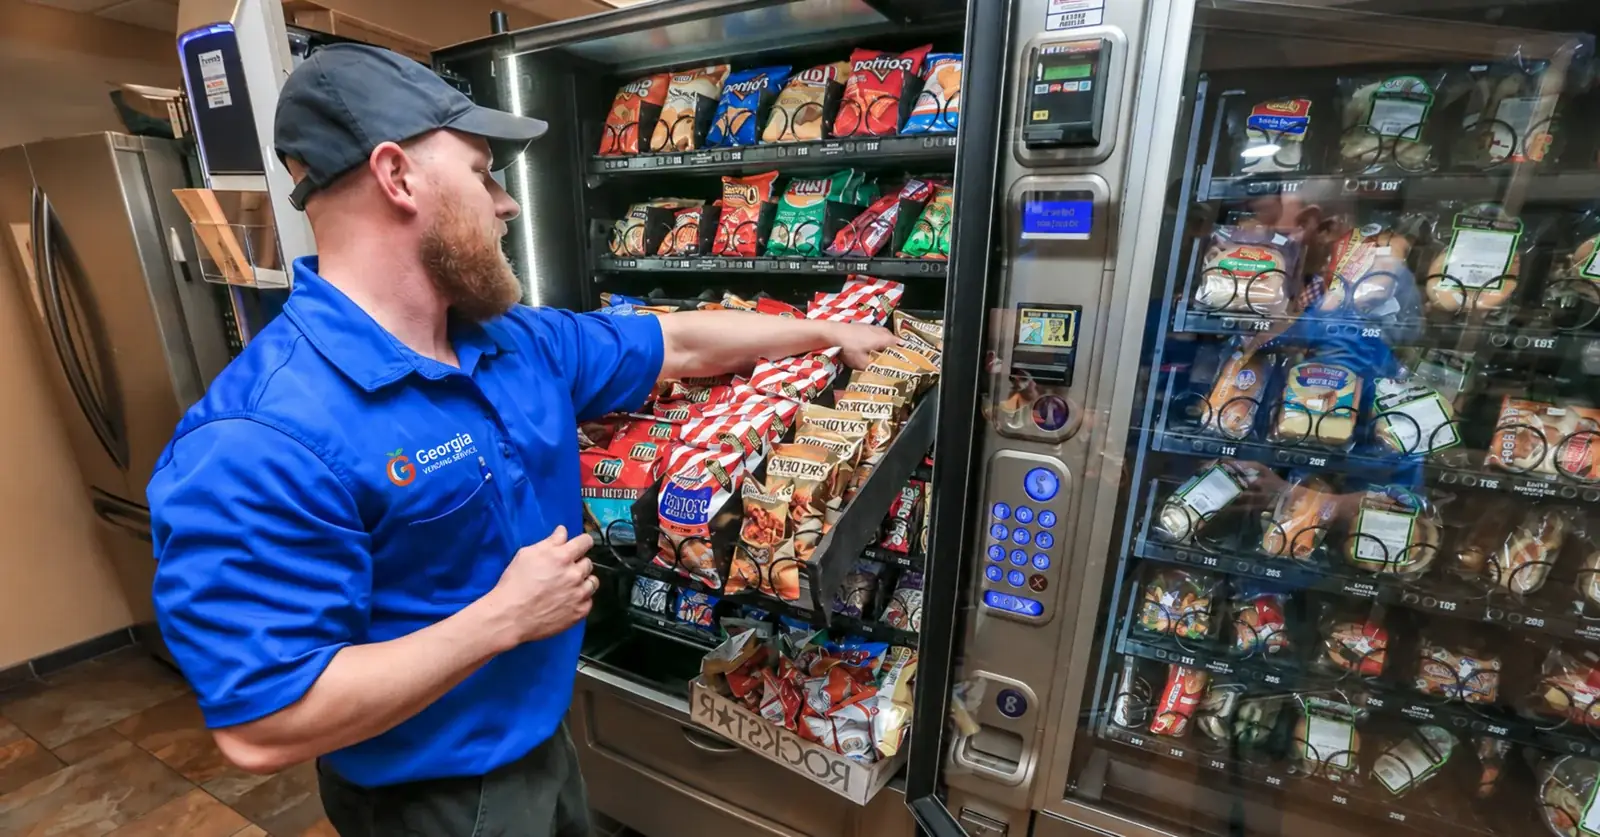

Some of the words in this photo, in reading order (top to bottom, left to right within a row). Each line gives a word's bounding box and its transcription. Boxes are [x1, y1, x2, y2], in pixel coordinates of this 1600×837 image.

[416, 433, 472, 464] Georgia
[422, 458, 453, 474] VENDING
[452, 446, 478, 462] SERVICE
